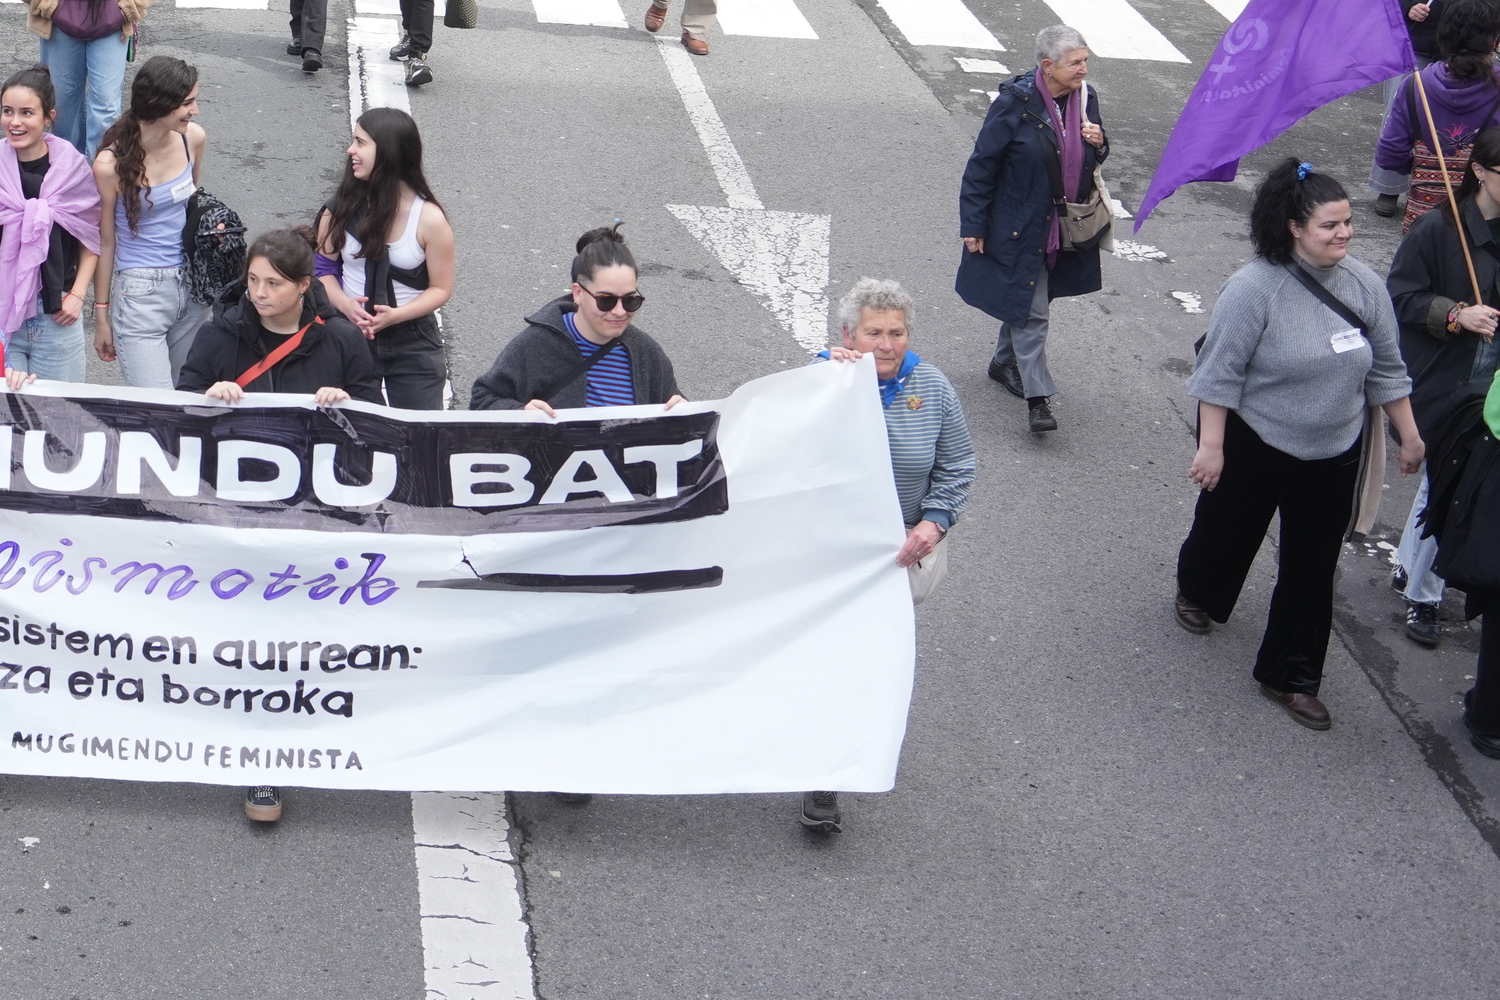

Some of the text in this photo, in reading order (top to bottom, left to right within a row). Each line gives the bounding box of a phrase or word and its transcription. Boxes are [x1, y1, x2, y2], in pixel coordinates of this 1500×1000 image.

[450, 439, 704, 508] BAT
[213, 635, 422, 674] aurrean:
[68, 667, 143, 703] eta
[163, 673, 354, 718] borroka
[13, 731, 193, 763] MUGIMENDU
[204, 745, 363, 771] FEMINISTA
